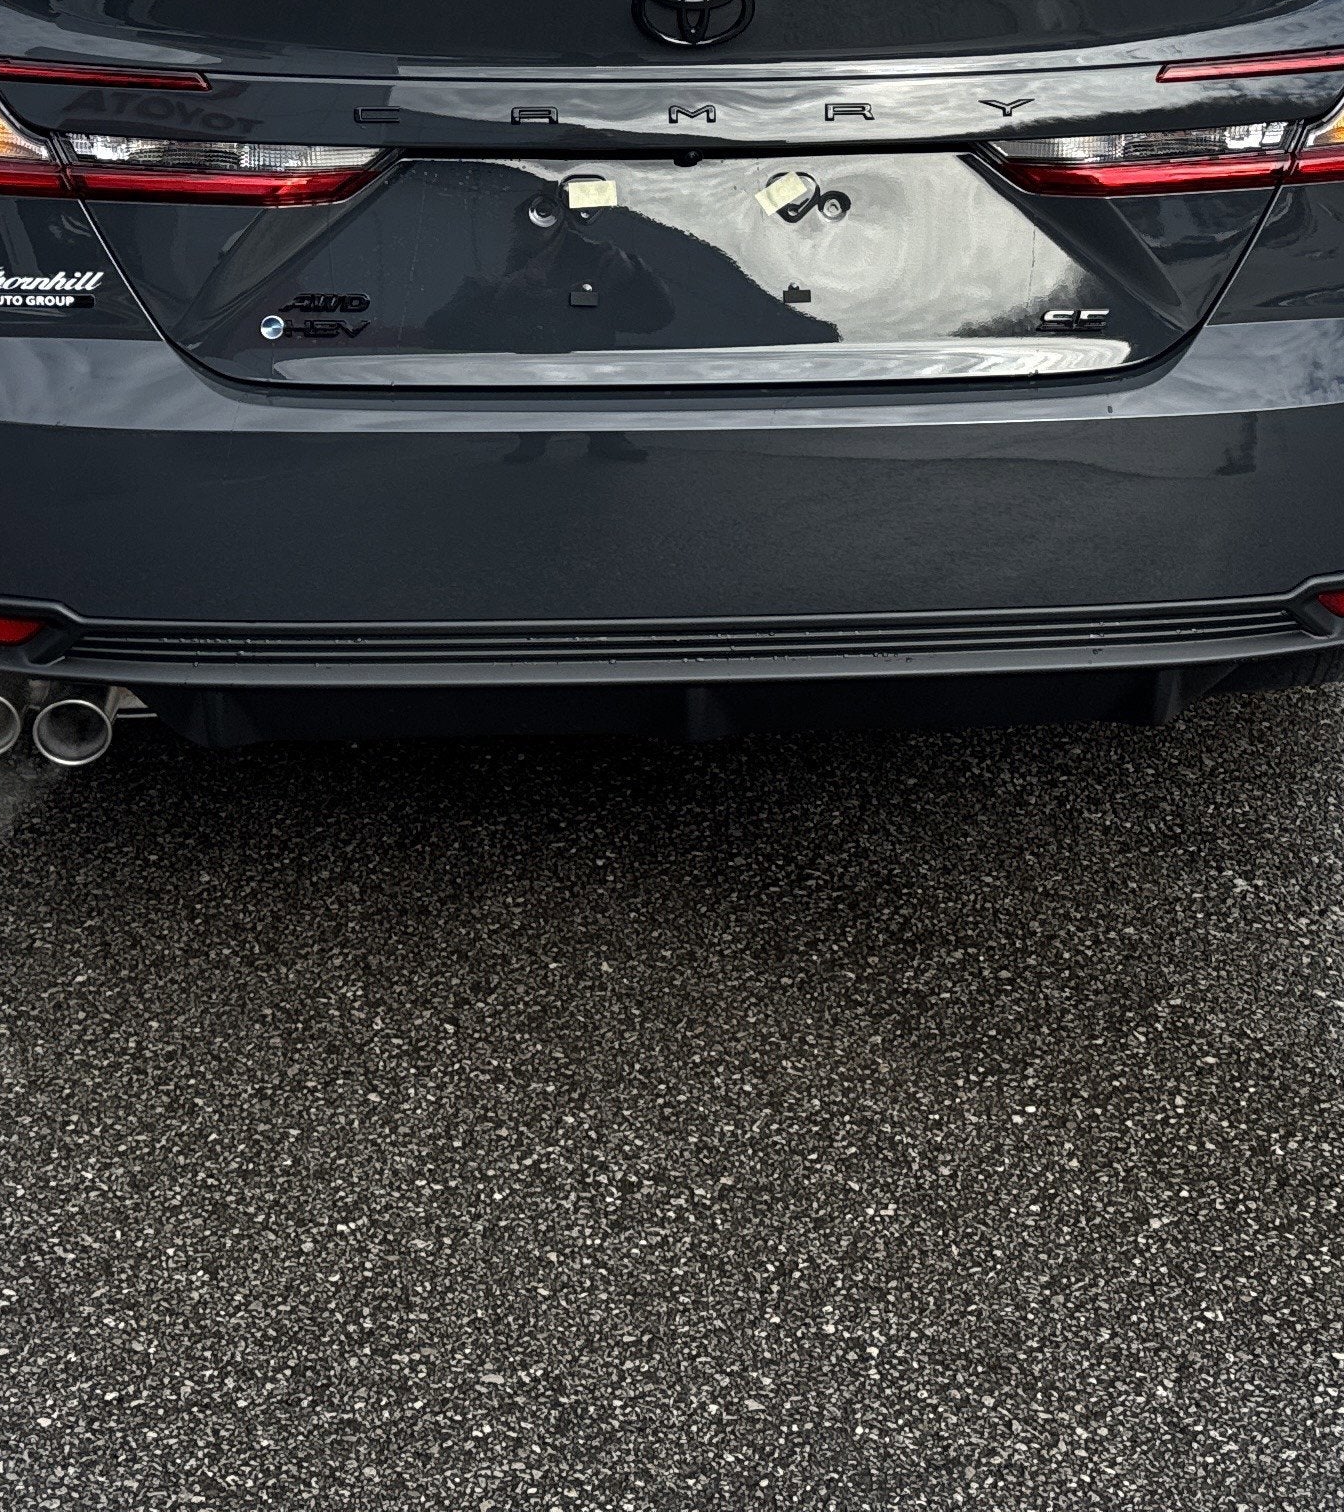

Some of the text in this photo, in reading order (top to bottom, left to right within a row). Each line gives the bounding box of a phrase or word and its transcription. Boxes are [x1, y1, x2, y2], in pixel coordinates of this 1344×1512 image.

[354, 98, 1036, 126] CAMRY
[25, 295, 75, 307] GROUP
[278, 293, 371, 313] AWD
[1038, 309, 1109, 332] SE
